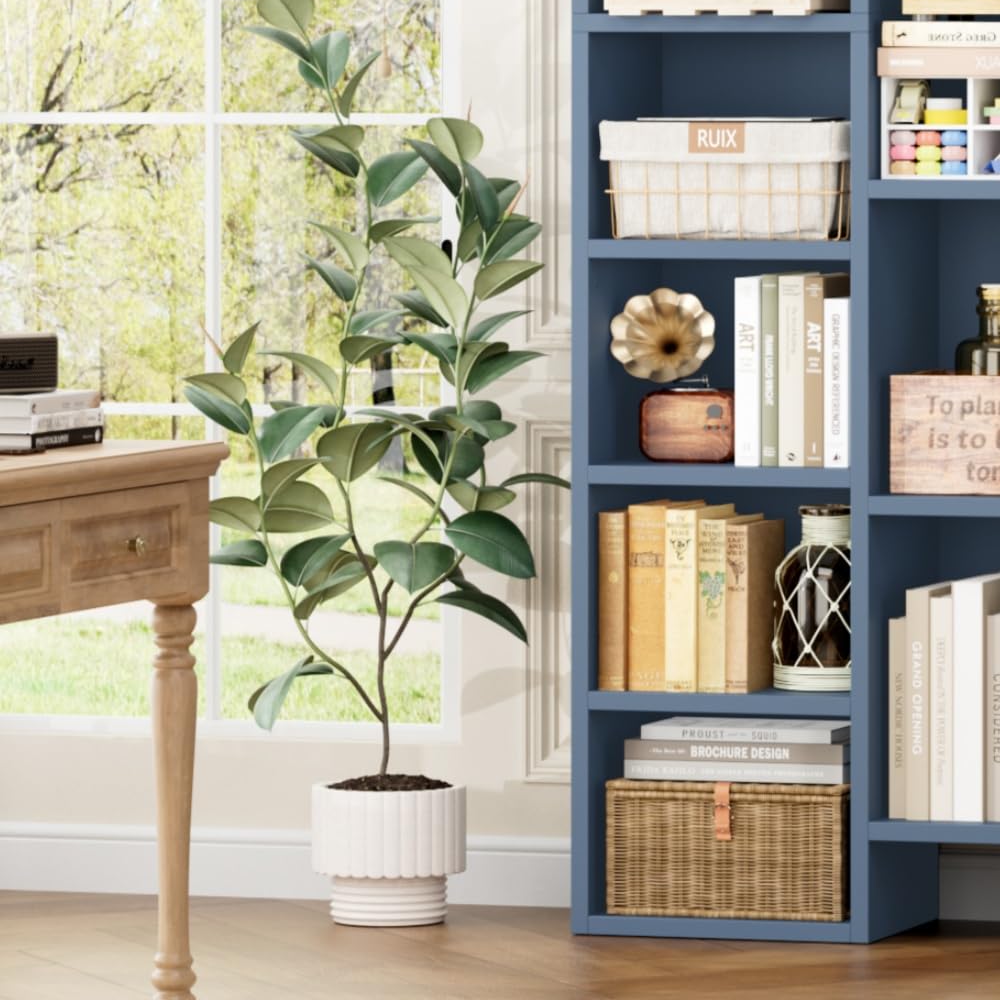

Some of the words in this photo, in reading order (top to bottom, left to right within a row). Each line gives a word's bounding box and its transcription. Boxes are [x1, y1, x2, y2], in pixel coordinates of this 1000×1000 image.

[697, 129, 738, 148] RUIX
[738, 322, 755, 352] ART
[806, 322, 822, 352] ART
[926, 395, 954, 416] To
[928, 427, 949, 450] is
[958, 429, 986, 450] to
[911, 640, 922, 688] GRAND
[682, 728, 725, 739] PROUST
[751, 730, 778, 740] SQUID
[911, 694, 922, 756] OPENING
[690, 745, 748, 759] BROCHURE
[750, 746, 790, 760] DESIGN
